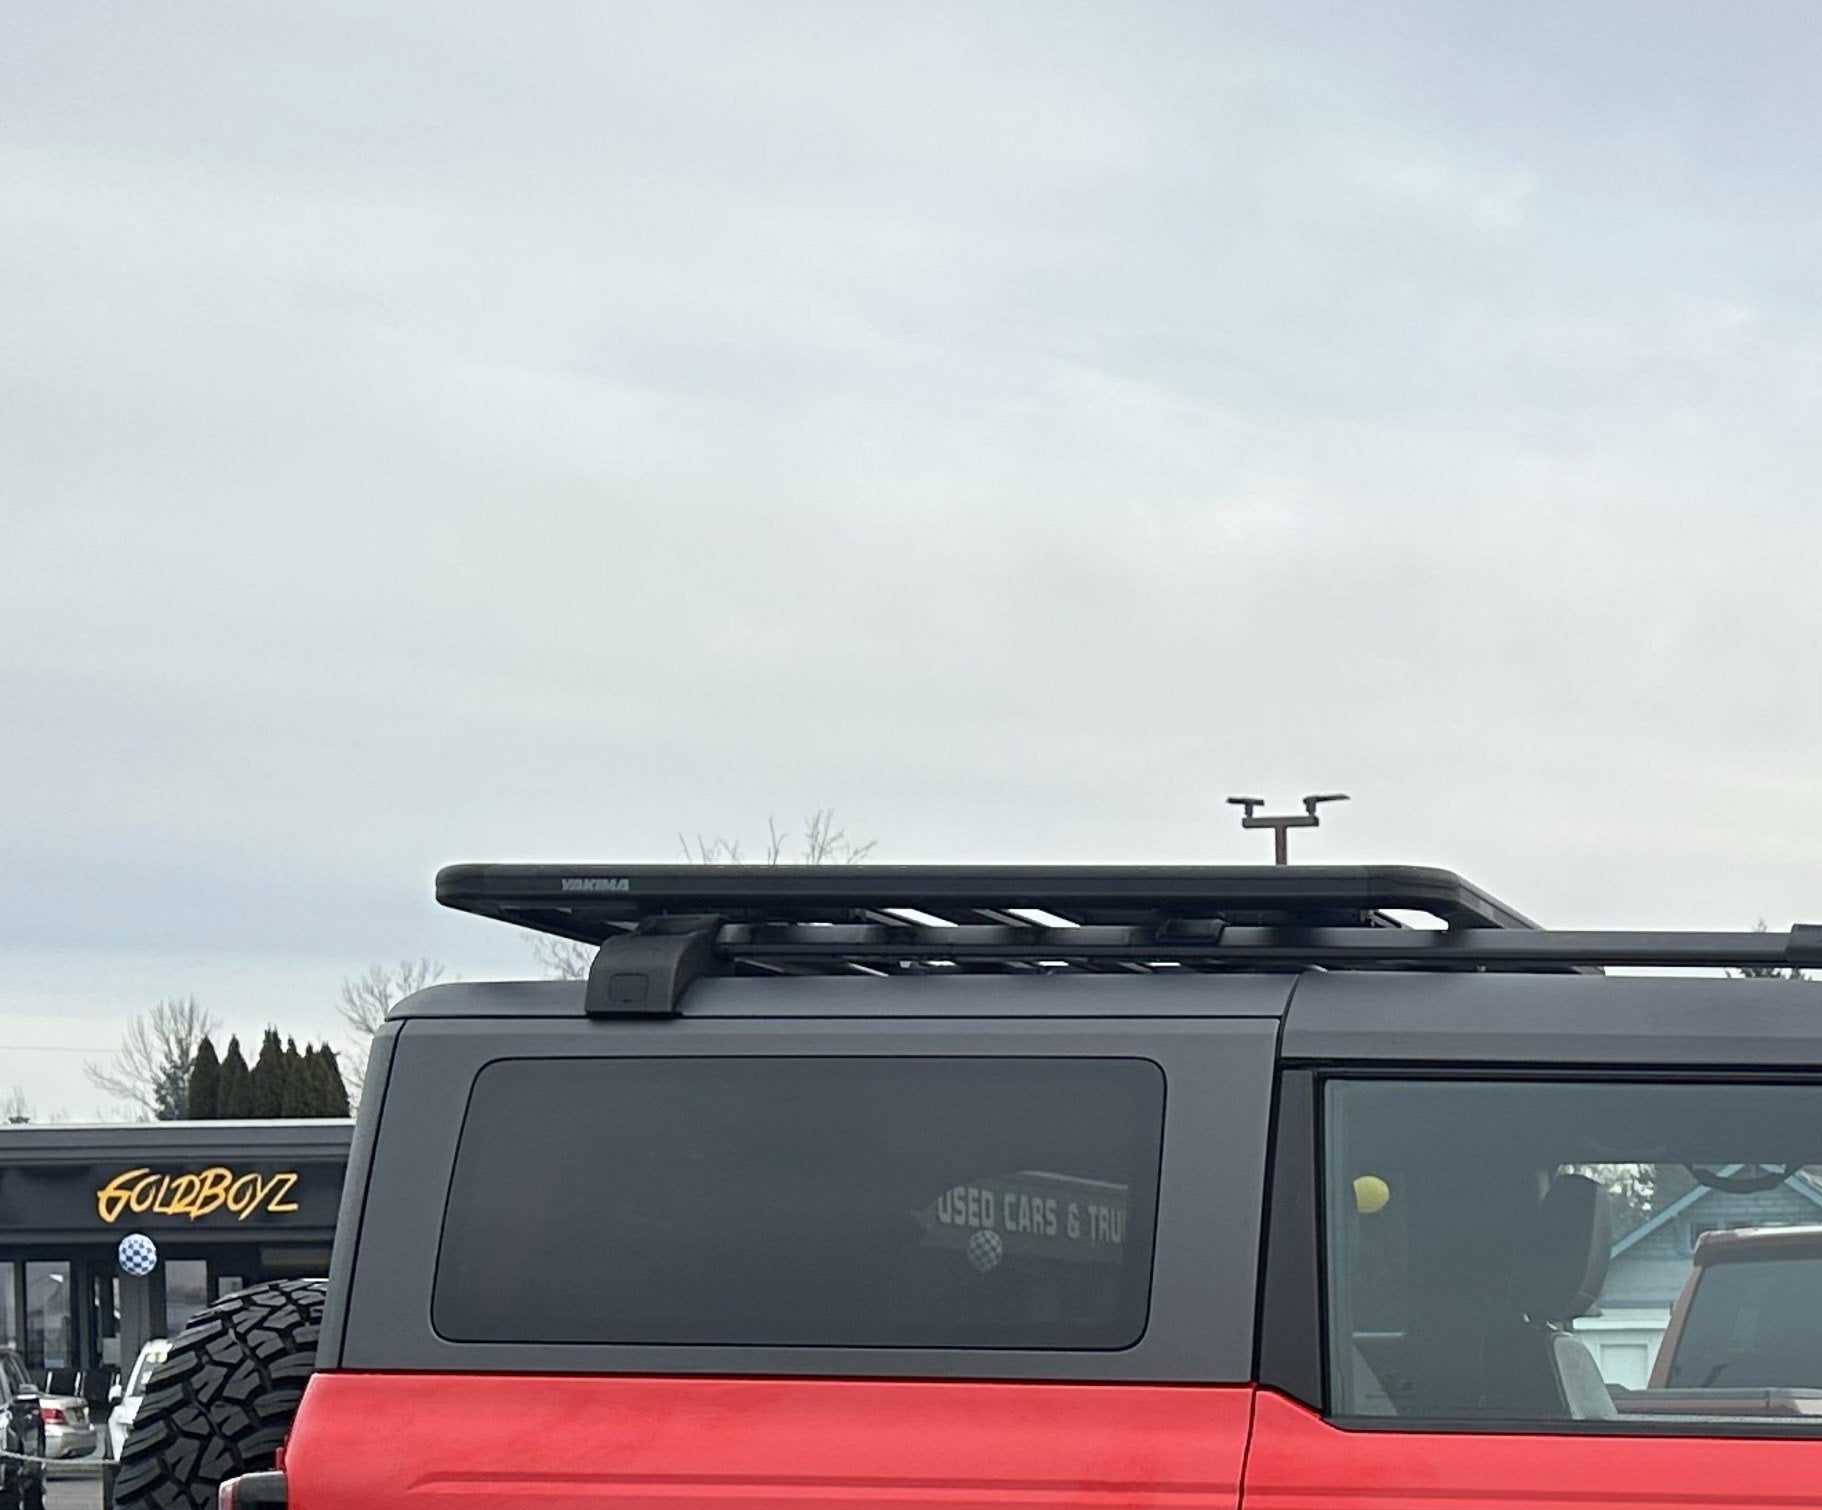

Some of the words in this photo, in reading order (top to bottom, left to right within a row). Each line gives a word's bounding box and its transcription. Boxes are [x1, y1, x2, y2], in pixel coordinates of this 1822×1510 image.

[937, 1186, 994, 1228] USED
[1004, 1193, 1057, 1236] CARS
[1067, 1202, 1080, 1239] &
[1088, 1205, 1126, 1243] TRU
